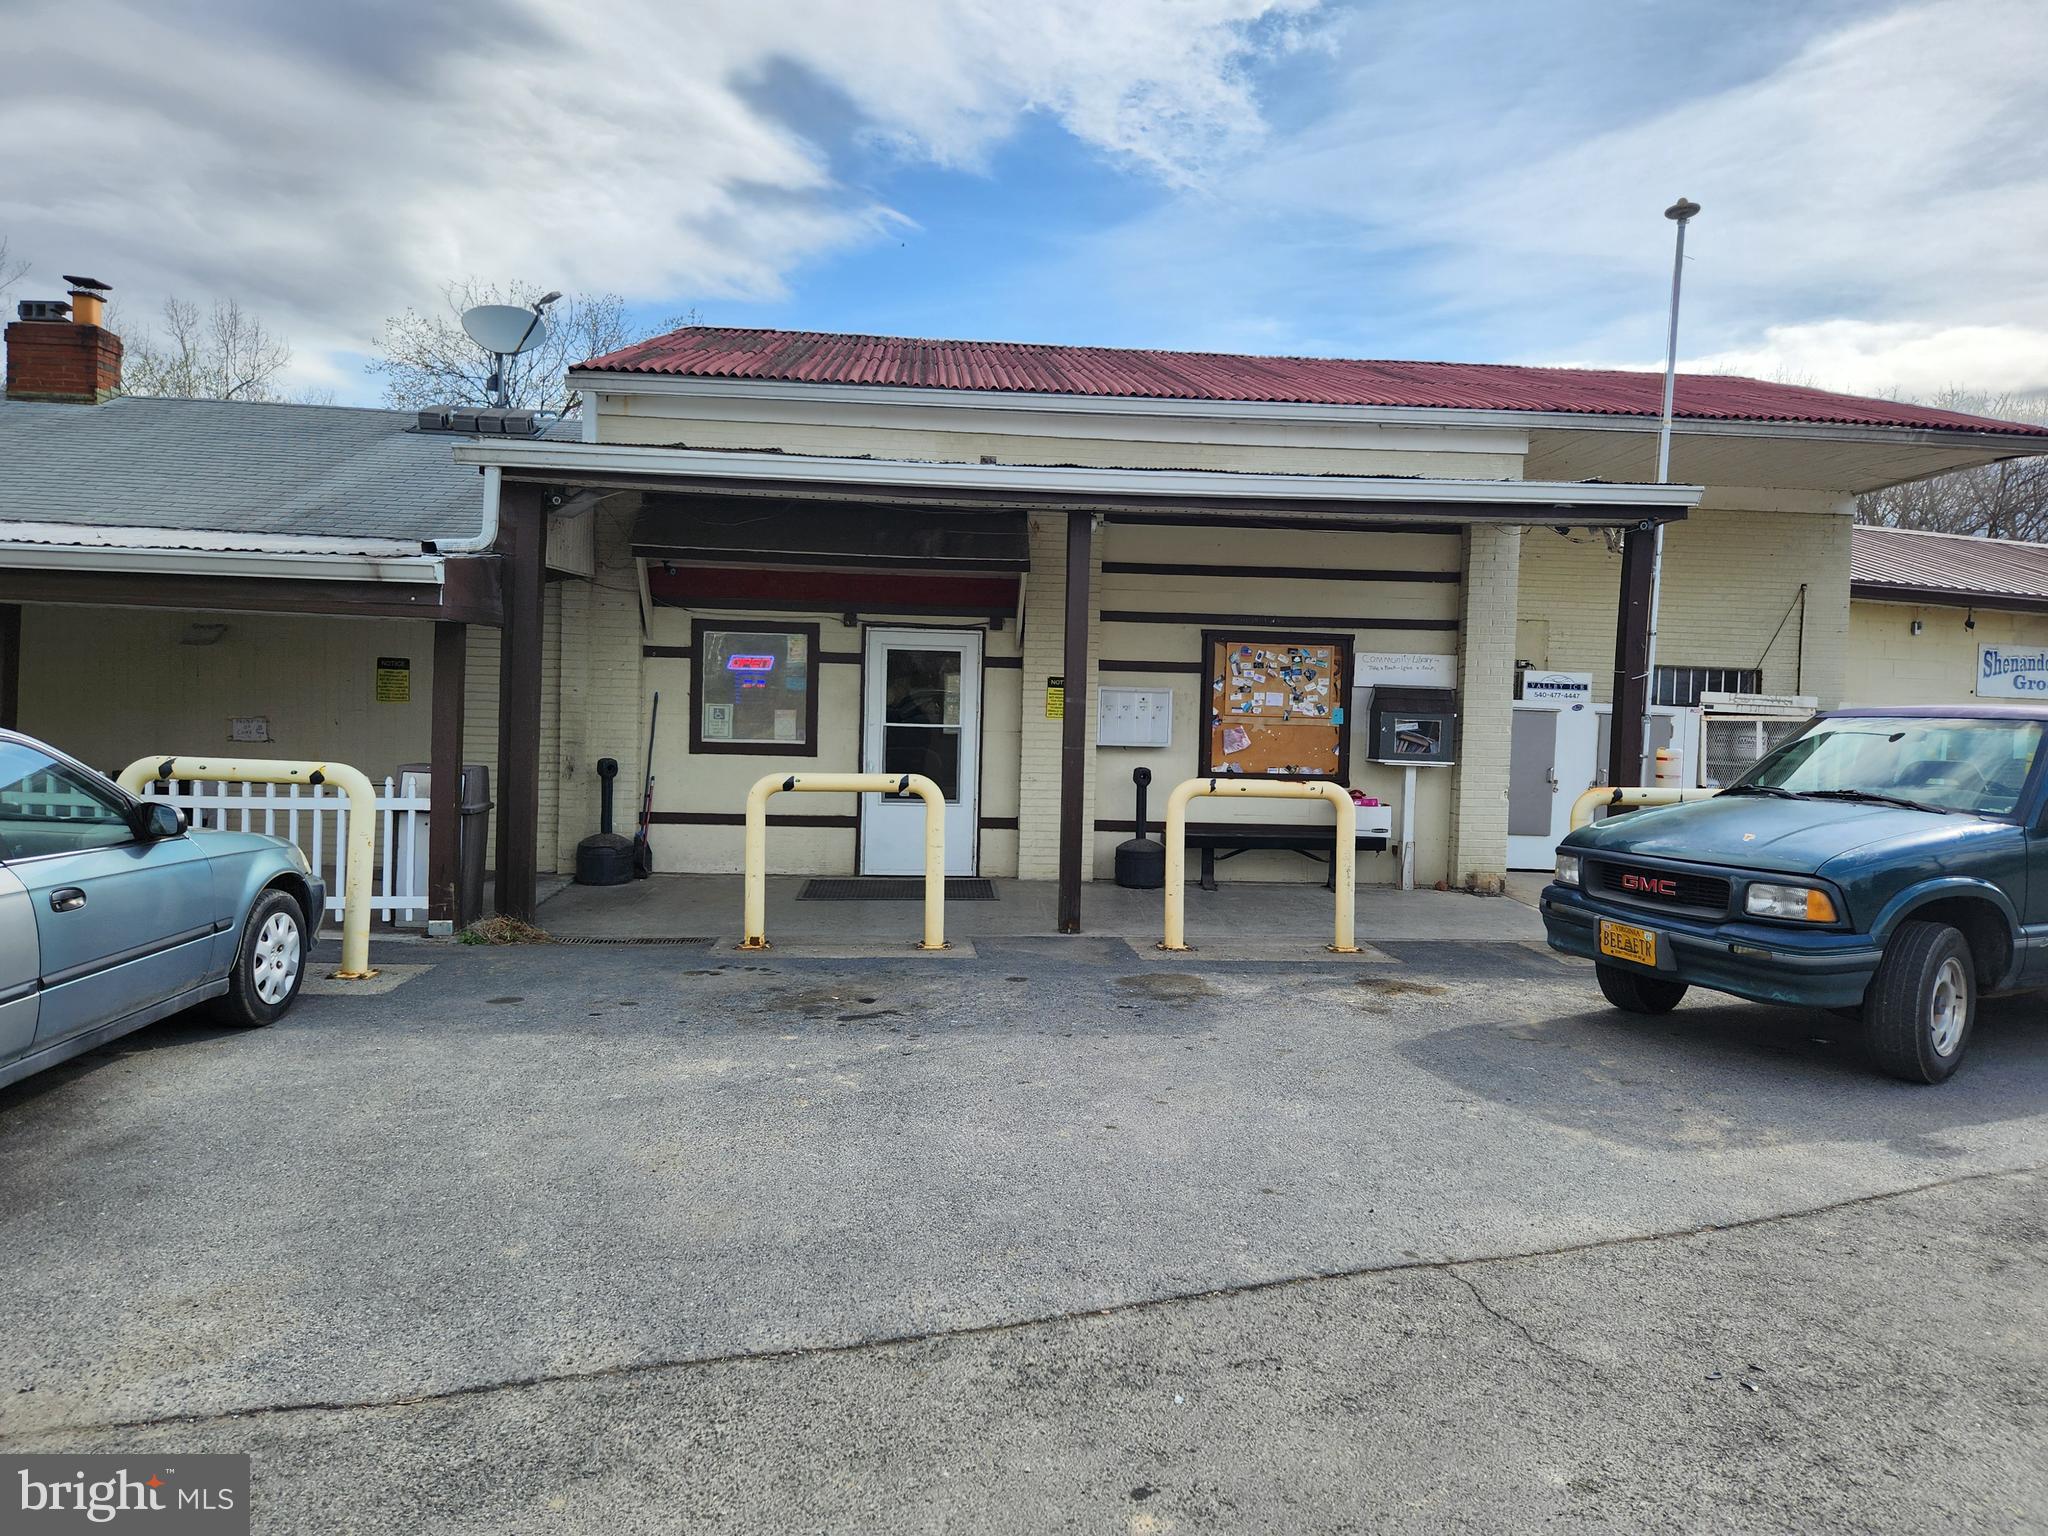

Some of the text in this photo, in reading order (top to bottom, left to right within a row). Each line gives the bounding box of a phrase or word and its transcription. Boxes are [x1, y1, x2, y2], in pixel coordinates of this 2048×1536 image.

[730, 657, 772, 669] OPEN
[1531, 682, 1564, 690] VALLEY
[2013, 675, 2048, 690] Gro
[1534, 691, 1580, 699] 540-477-4447
[1621, 874, 1677, 896] GMC
